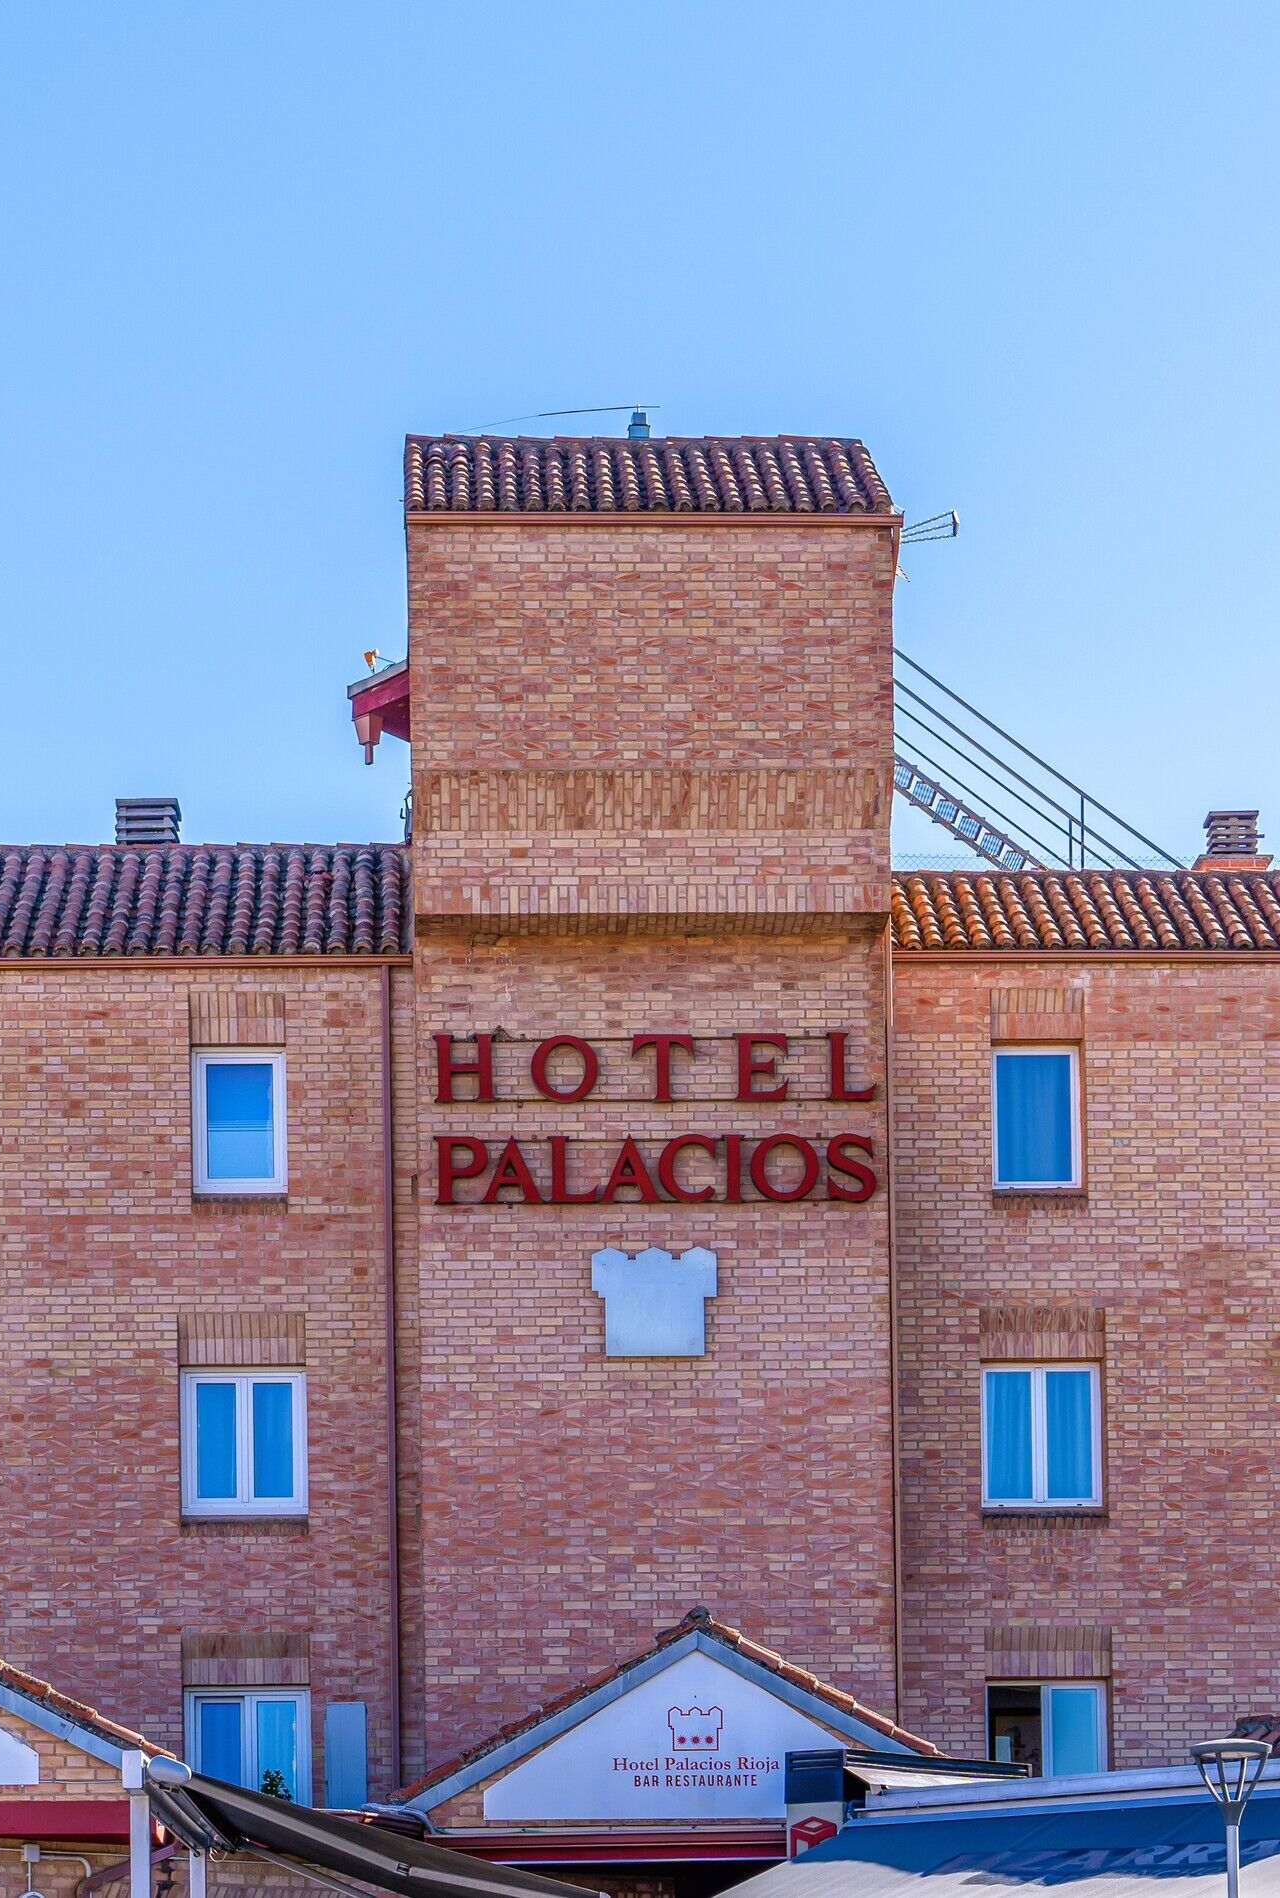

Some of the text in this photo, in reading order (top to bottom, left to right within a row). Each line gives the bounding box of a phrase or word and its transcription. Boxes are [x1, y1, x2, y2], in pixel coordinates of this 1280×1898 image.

[433, 1032, 878, 1103] HOTEL
[433, 1133, 878, 1205] PALACIOS
[612, 1756, 780, 1773] Hotel Palacios Rioja
[634, 1774, 757, 1788] BAR RESTAURANTE
